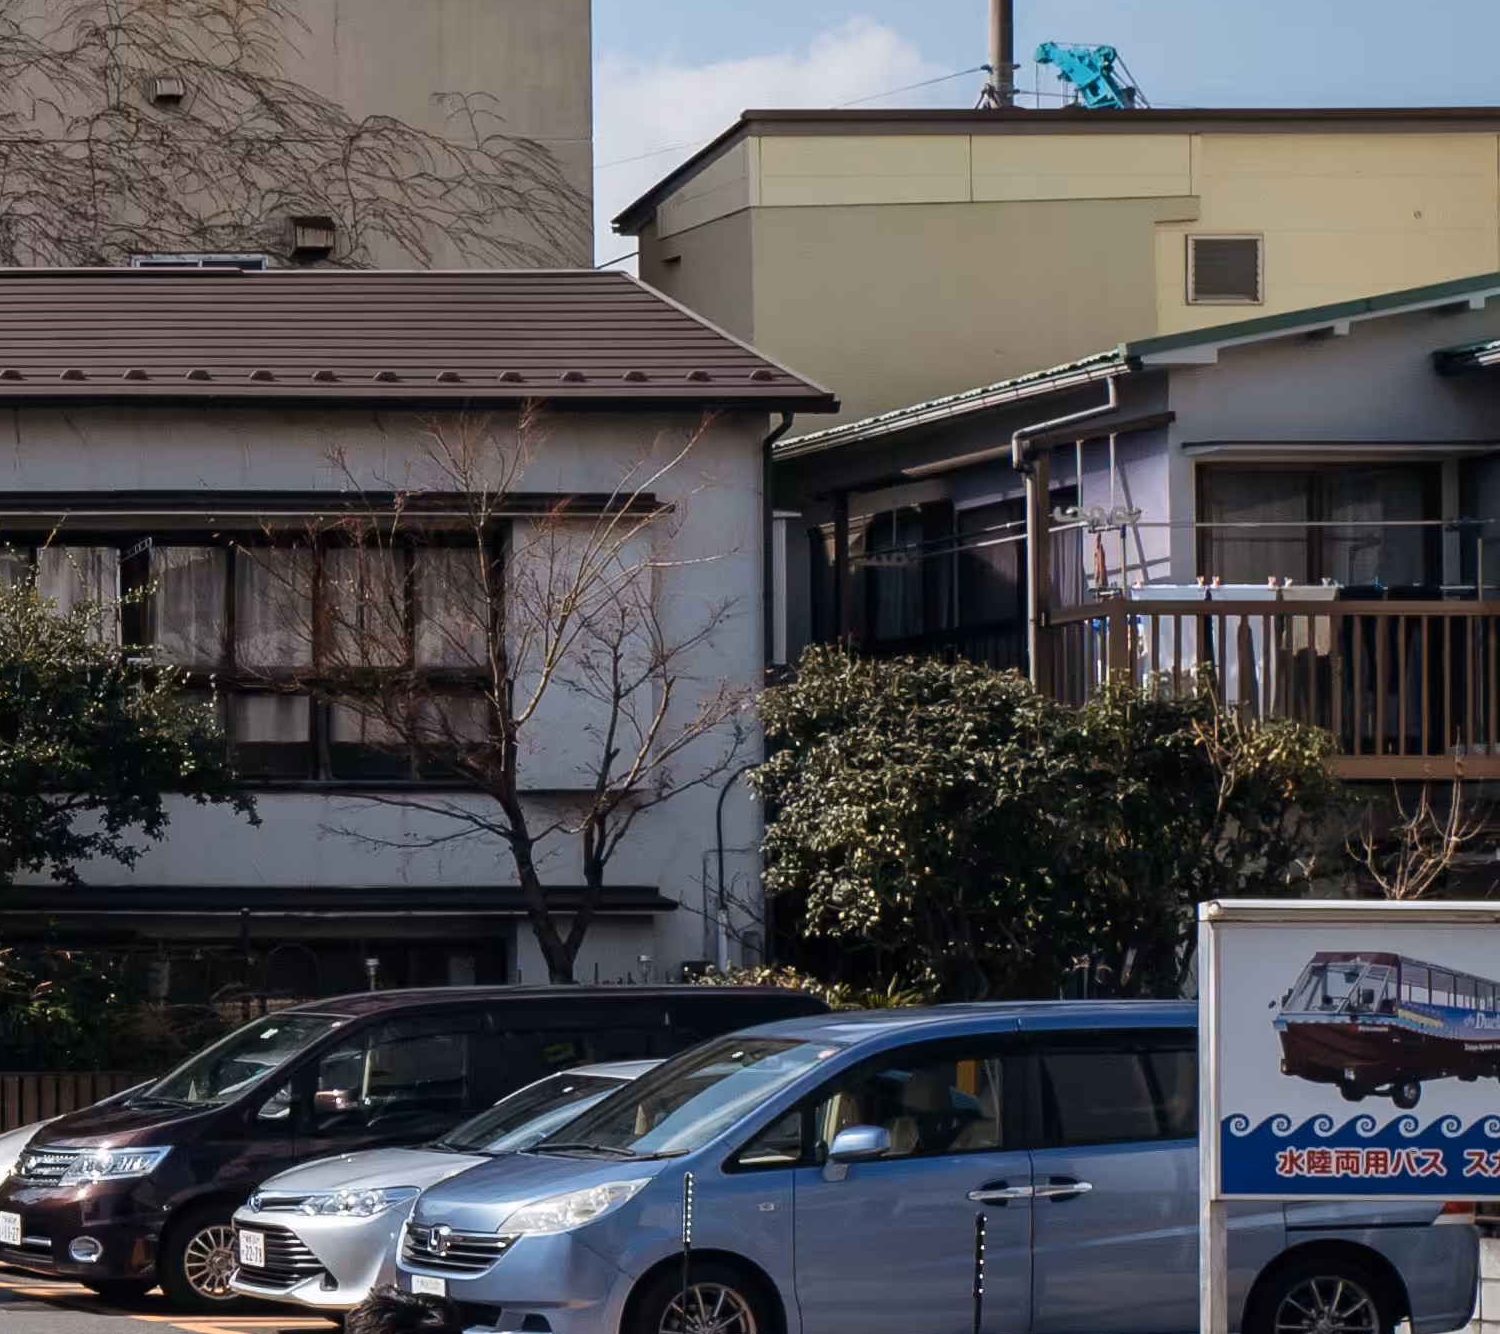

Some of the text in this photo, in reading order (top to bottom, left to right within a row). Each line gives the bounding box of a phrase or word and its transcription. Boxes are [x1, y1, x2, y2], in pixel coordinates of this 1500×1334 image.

[1276, 1146, 1447, 1177] 水陸両用バス
